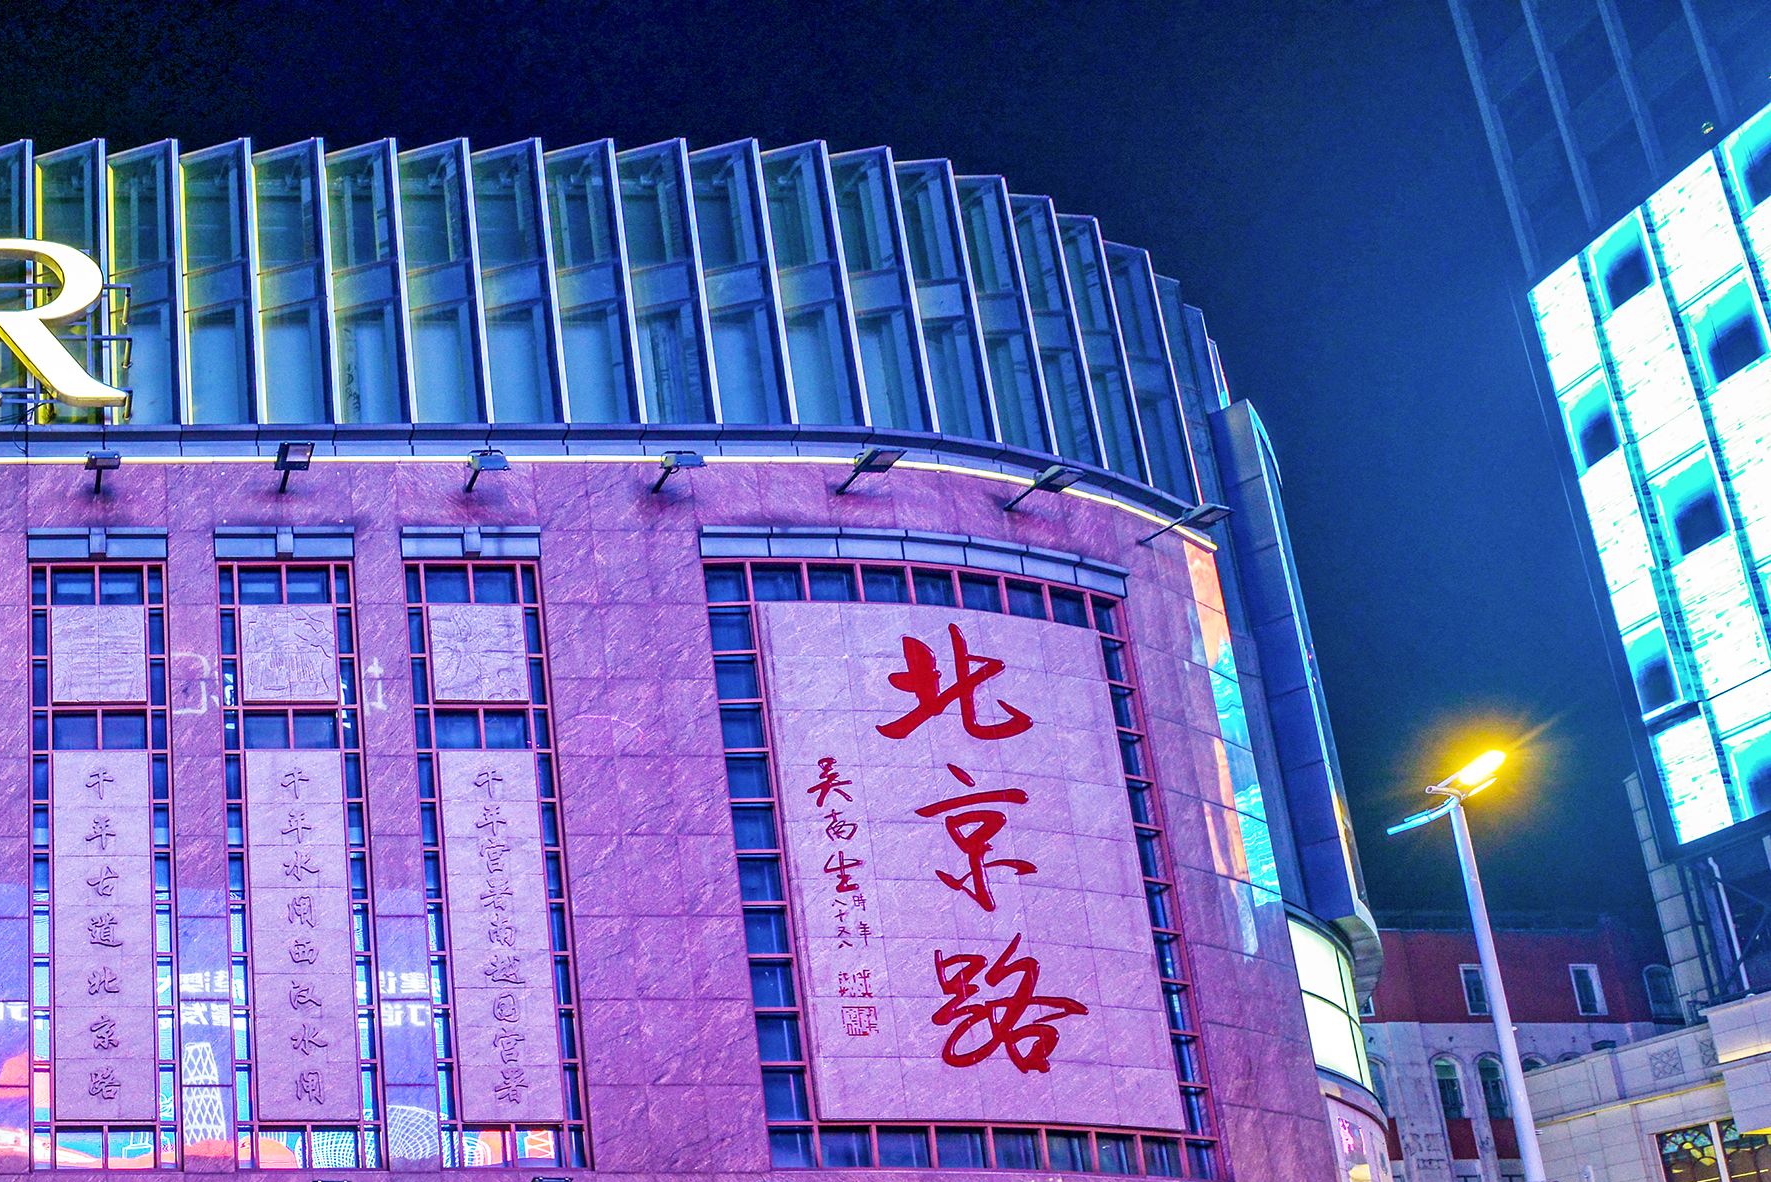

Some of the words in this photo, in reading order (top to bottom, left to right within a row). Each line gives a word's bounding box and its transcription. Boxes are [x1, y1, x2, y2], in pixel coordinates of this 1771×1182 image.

[84, 767, 124, 1102] 千年古道北京路
[874, 622, 1090, 1075] 北京路
